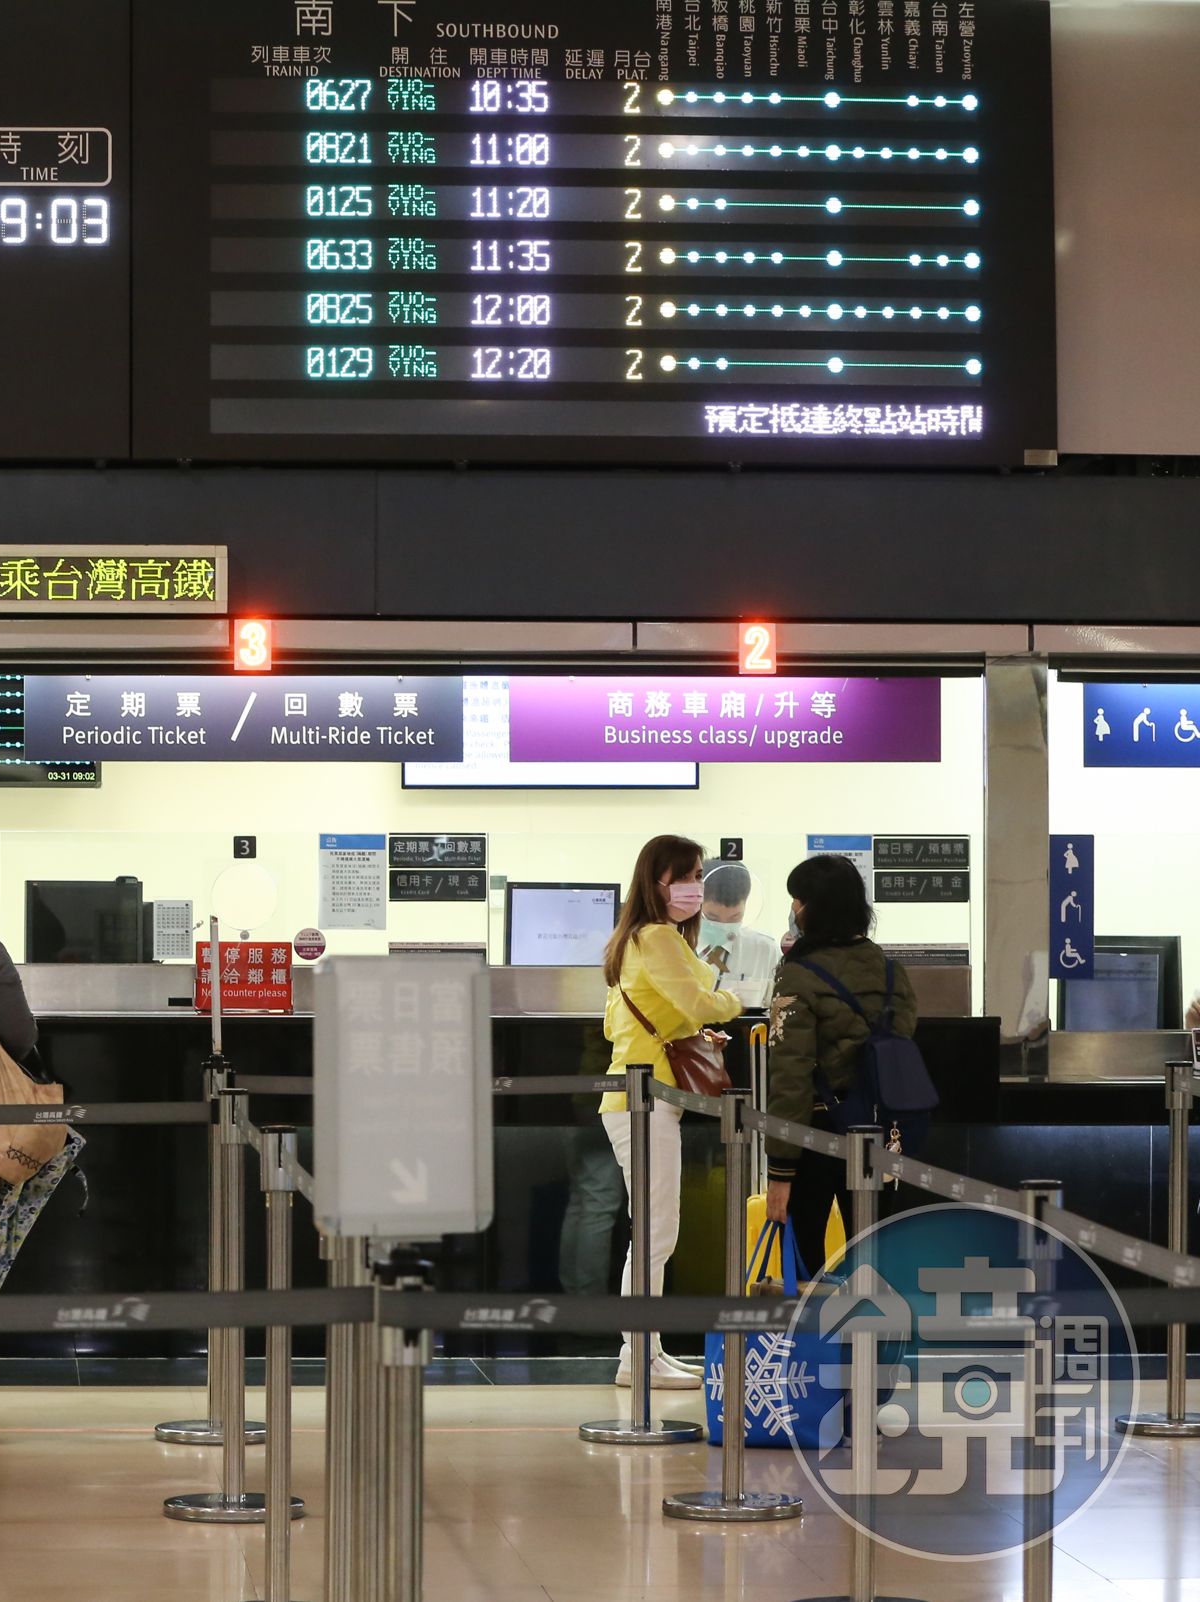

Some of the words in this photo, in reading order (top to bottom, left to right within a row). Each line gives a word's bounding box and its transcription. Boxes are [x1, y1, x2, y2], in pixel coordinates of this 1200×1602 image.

[295, 0, 416, 36] 南下
[437, 23, 558, 38] SOUTHBOUND
[656, 0, 672, 30] 南港
[685, 0, 700, 31] 台北
[712, 0, 728, 32] 板橋
[739, 0, 755, 32] 桃園
[766, 0, 783, 33] 新竹
[794, 0, 810, 33] 苗栗
[822, 0, 838, 34] 台中
[849, 0, 865, 35] 彰化
[878, 0, 894, 35] 雲林
[904, 1, 920, 36] 嘉義
[931, 2, 948, 37] 台南
[958, 2, 975, 37] 左營
[252, 46, 331, 66] 列車車次
[392, 47, 447, 64] 開往
[470, 48, 548, 68] 開車時間
[379, 66, 461, 79] DESTINATION
[565, 68, 604, 80] DELAY
[305, 79, 372, 112] 0627
[469, 80, 550, 113] 10:35
[305, 132, 373, 164] 0821
[469, 133, 550, 166] 11:00
[20, 167, 59, 181] TIME
[305, 186, 373, 217] 0125
[469, 187, 550, 219] 11:20
[306, 239, 373, 271] 0633
[470, 240, 551, 272] 11:35
[306, 293, 373, 325] 0825
[470, 294, 551, 326] 12:00
[306, 346, 373, 378] 0129
[470, 348, 551, 380] 12:20
[239, 621, 267, 666] 3
[743, 625, 772, 669] 2
[65, 691, 202, 718] 定期票
[284, 691, 419, 718] 回數票
[606, 689, 838, 719] 商務車廂/升等
[62, 725, 142, 745] Periodic
[147, 725, 206, 745] Ticket
[270, 725, 371, 745] Multi-Ride
[376, 725, 435, 746] Ticket
[604, 725, 694, 745] Business
[698, 724, 758, 748] class/
[764, 727, 844, 749] upgrade
[48, 771, 70, 781] 03-31
[72, 771, 95, 781] 09:02
[240, 839, 250, 855] 3
[727, 842, 738, 857] 2
